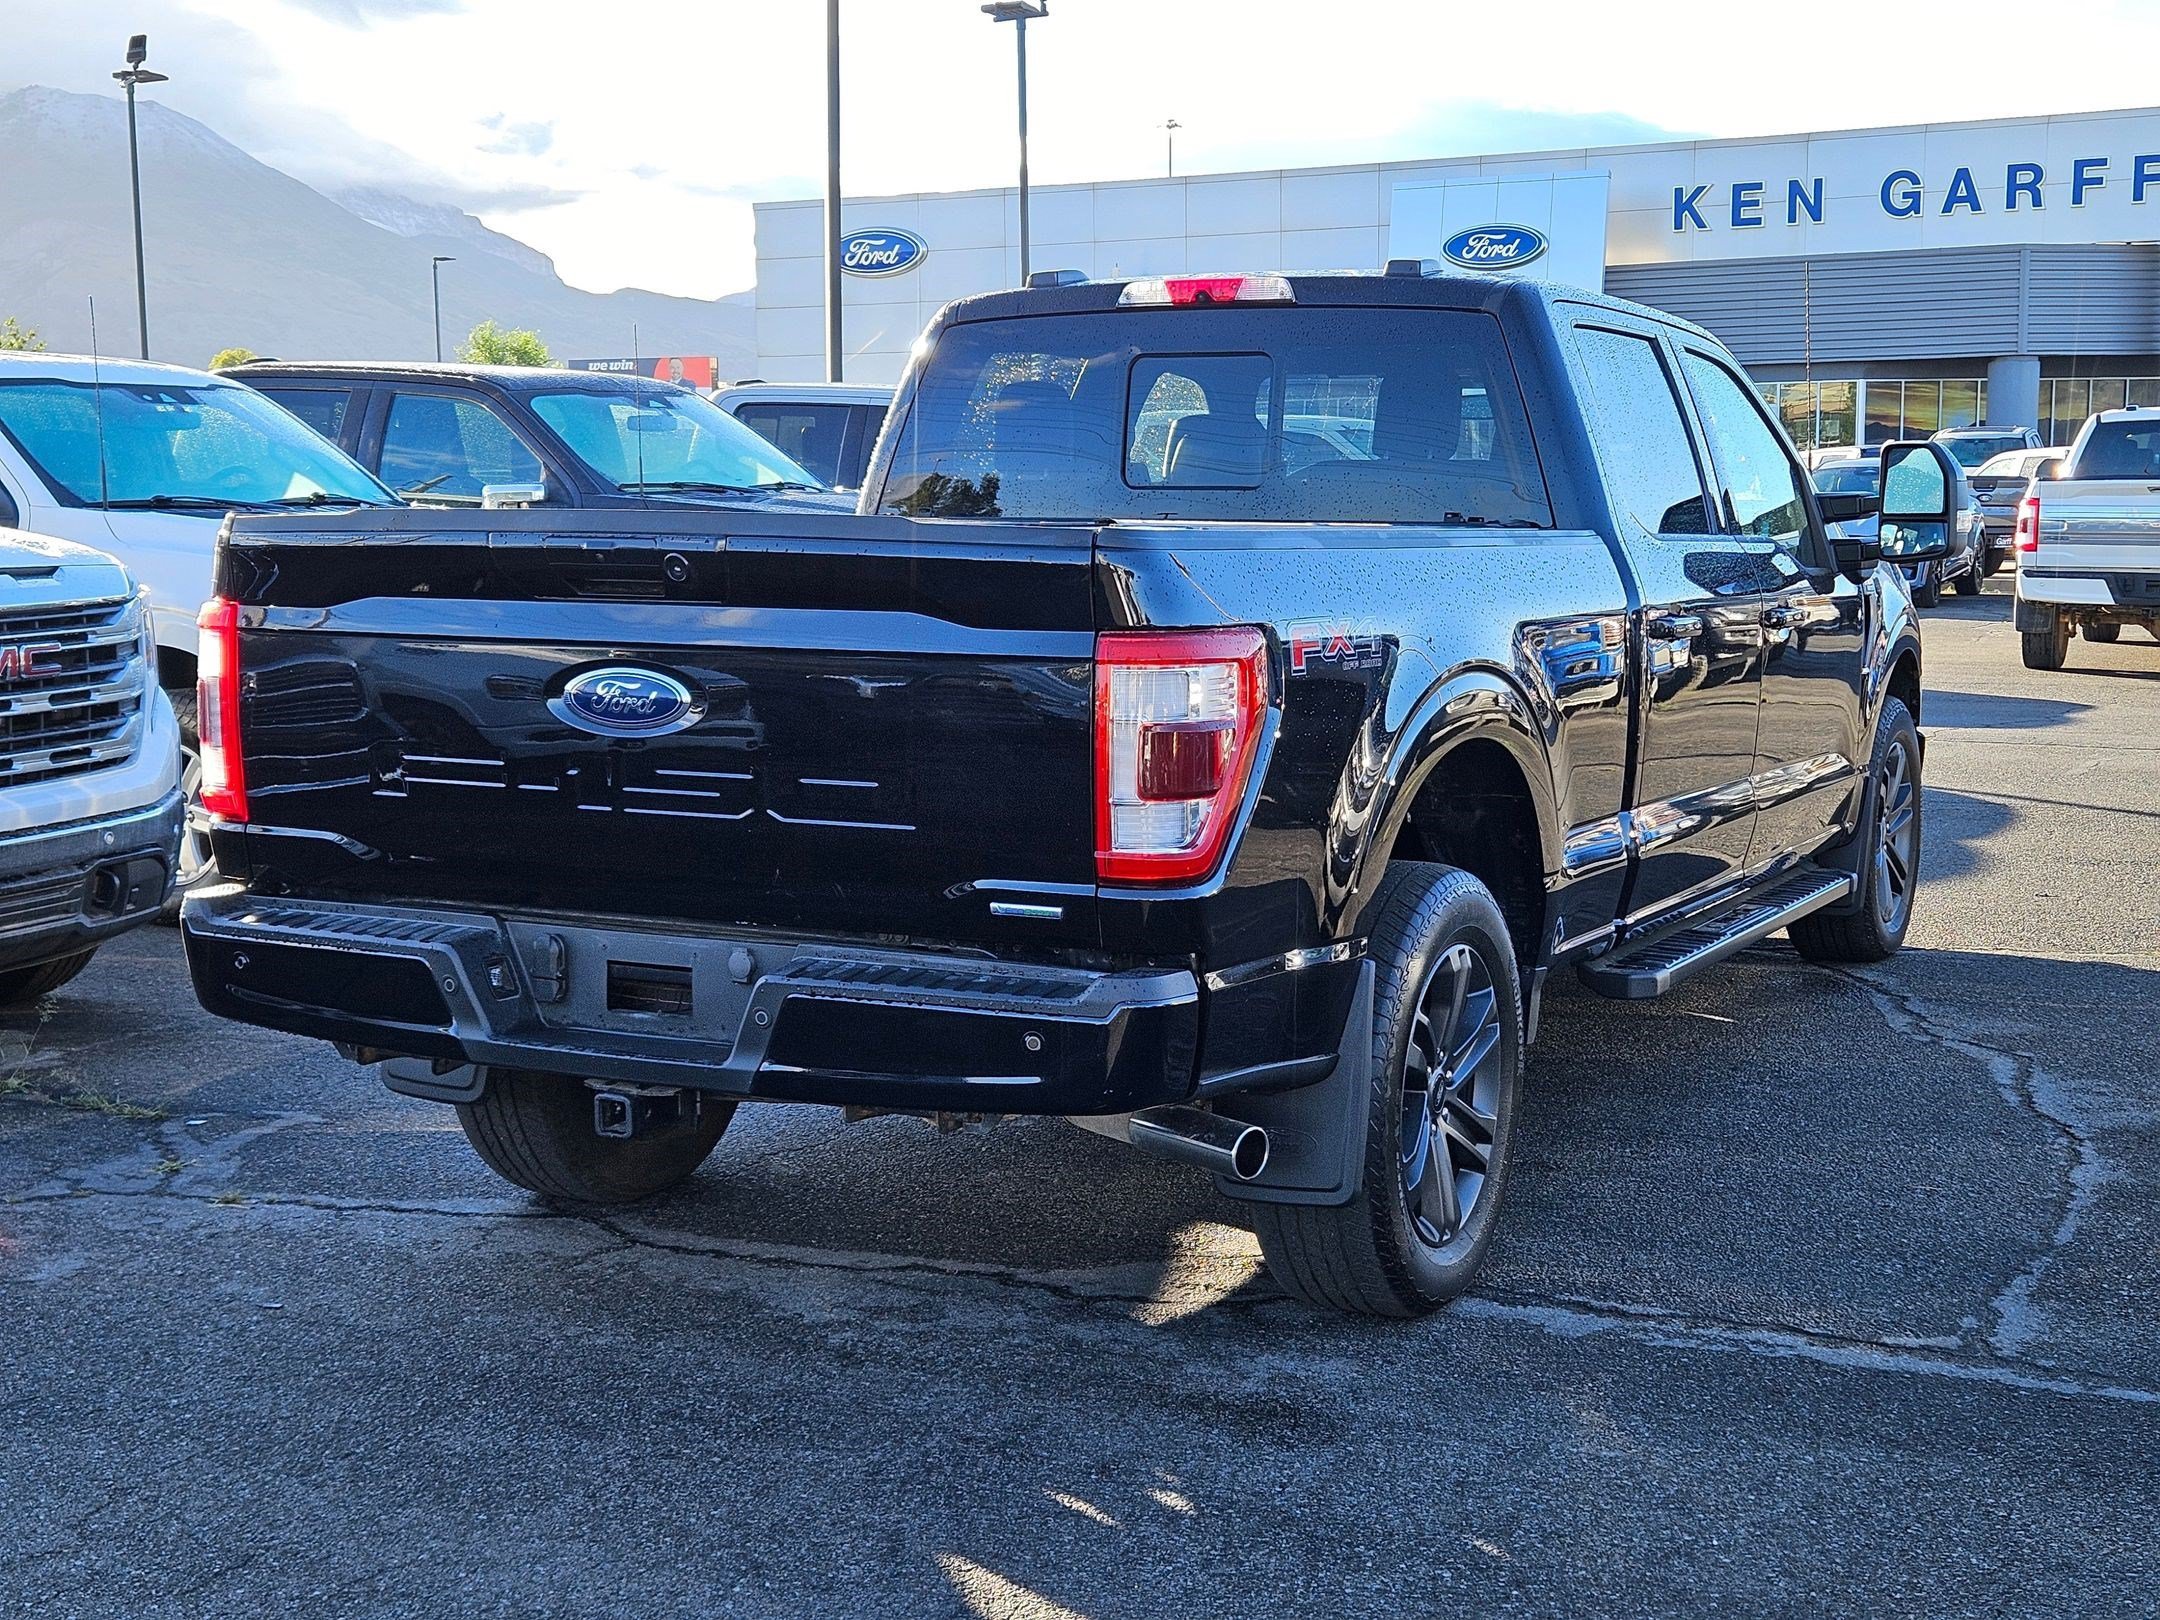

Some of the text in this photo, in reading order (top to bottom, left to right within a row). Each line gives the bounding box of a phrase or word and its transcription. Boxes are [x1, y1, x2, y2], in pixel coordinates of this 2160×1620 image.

[1672, 153, 2160, 232] KEN GARFF
[844, 239, 900, 266] Ford
[1462, 233, 1520, 259] Ford
[588, 361, 608, 371] we
[1288, 617, 1383, 676] FX4
[591, 680, 658, 715] Ford
